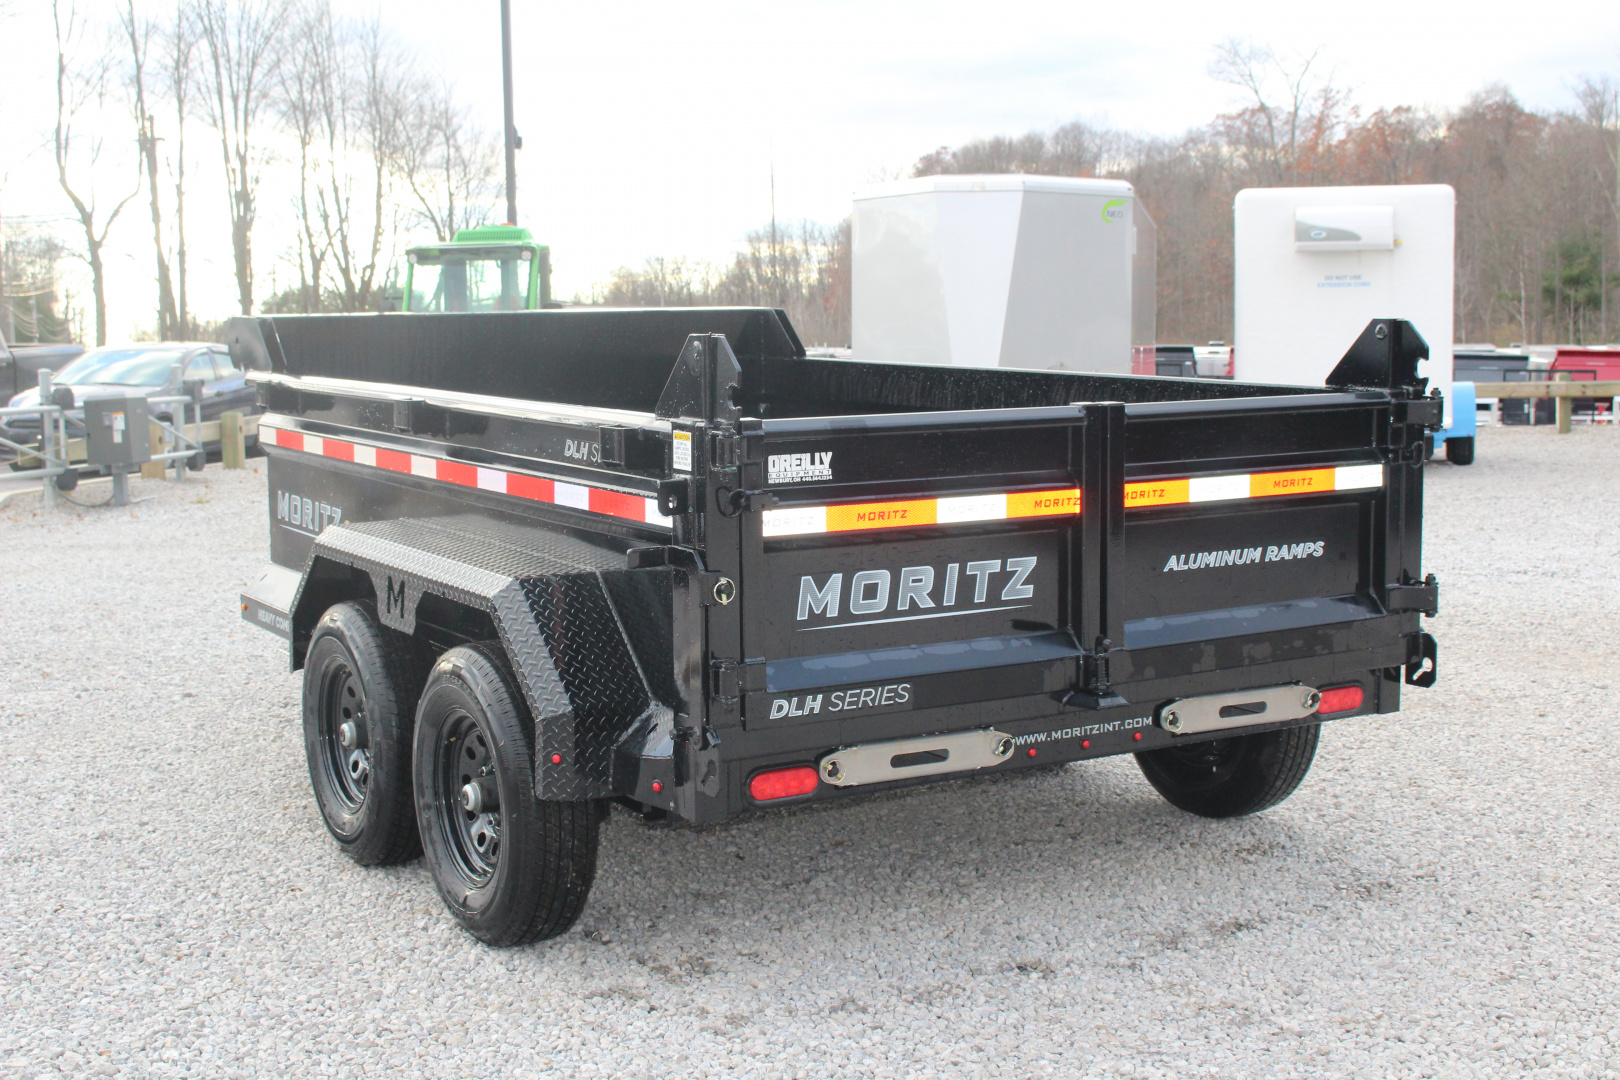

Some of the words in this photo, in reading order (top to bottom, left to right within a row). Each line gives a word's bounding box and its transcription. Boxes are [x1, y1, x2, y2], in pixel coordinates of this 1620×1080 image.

[1106, 210, 1123, 219] NEO
[564, 439, 588, 460] DLH
[768, 469, 831, 478] EQUIPMENT
[1273, 477, 1313, 488] MORITZ
[1034, 497, 1081, 508] MORITZ
[856, 509, 908, 522] MORITZ
[1164, 547, 1262, 572] ALUMINUM
[1265, 541, 1325, 562] RAMPS
[387, 575, 405, 619] M
[797, 556, 1037, 620] MORITZ
[257, 608, 275, 625] HEAVY
[770, 694, 823, 720] DLH
[828, 683, 911, 712] SERIES
[1014, 716, 1152, 746] WWW.MORITZINT.COM
